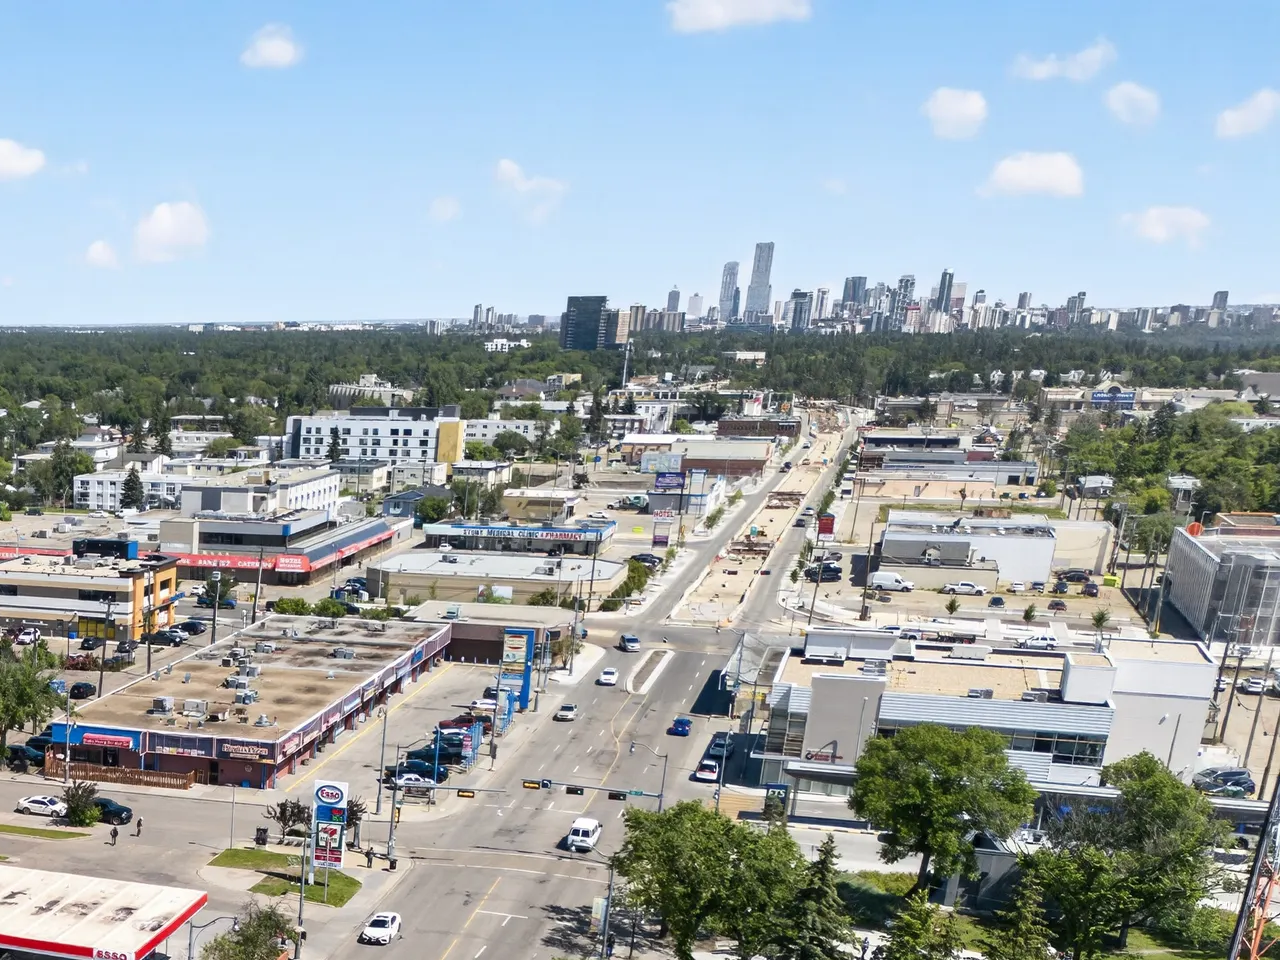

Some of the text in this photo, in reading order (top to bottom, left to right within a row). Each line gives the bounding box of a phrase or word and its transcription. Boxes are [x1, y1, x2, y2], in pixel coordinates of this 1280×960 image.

[487, 529, 514, 537] MEDICAL
[518, 531, 540, 539] CLINIC
[544, 532, 582, 541] PHARMACY
